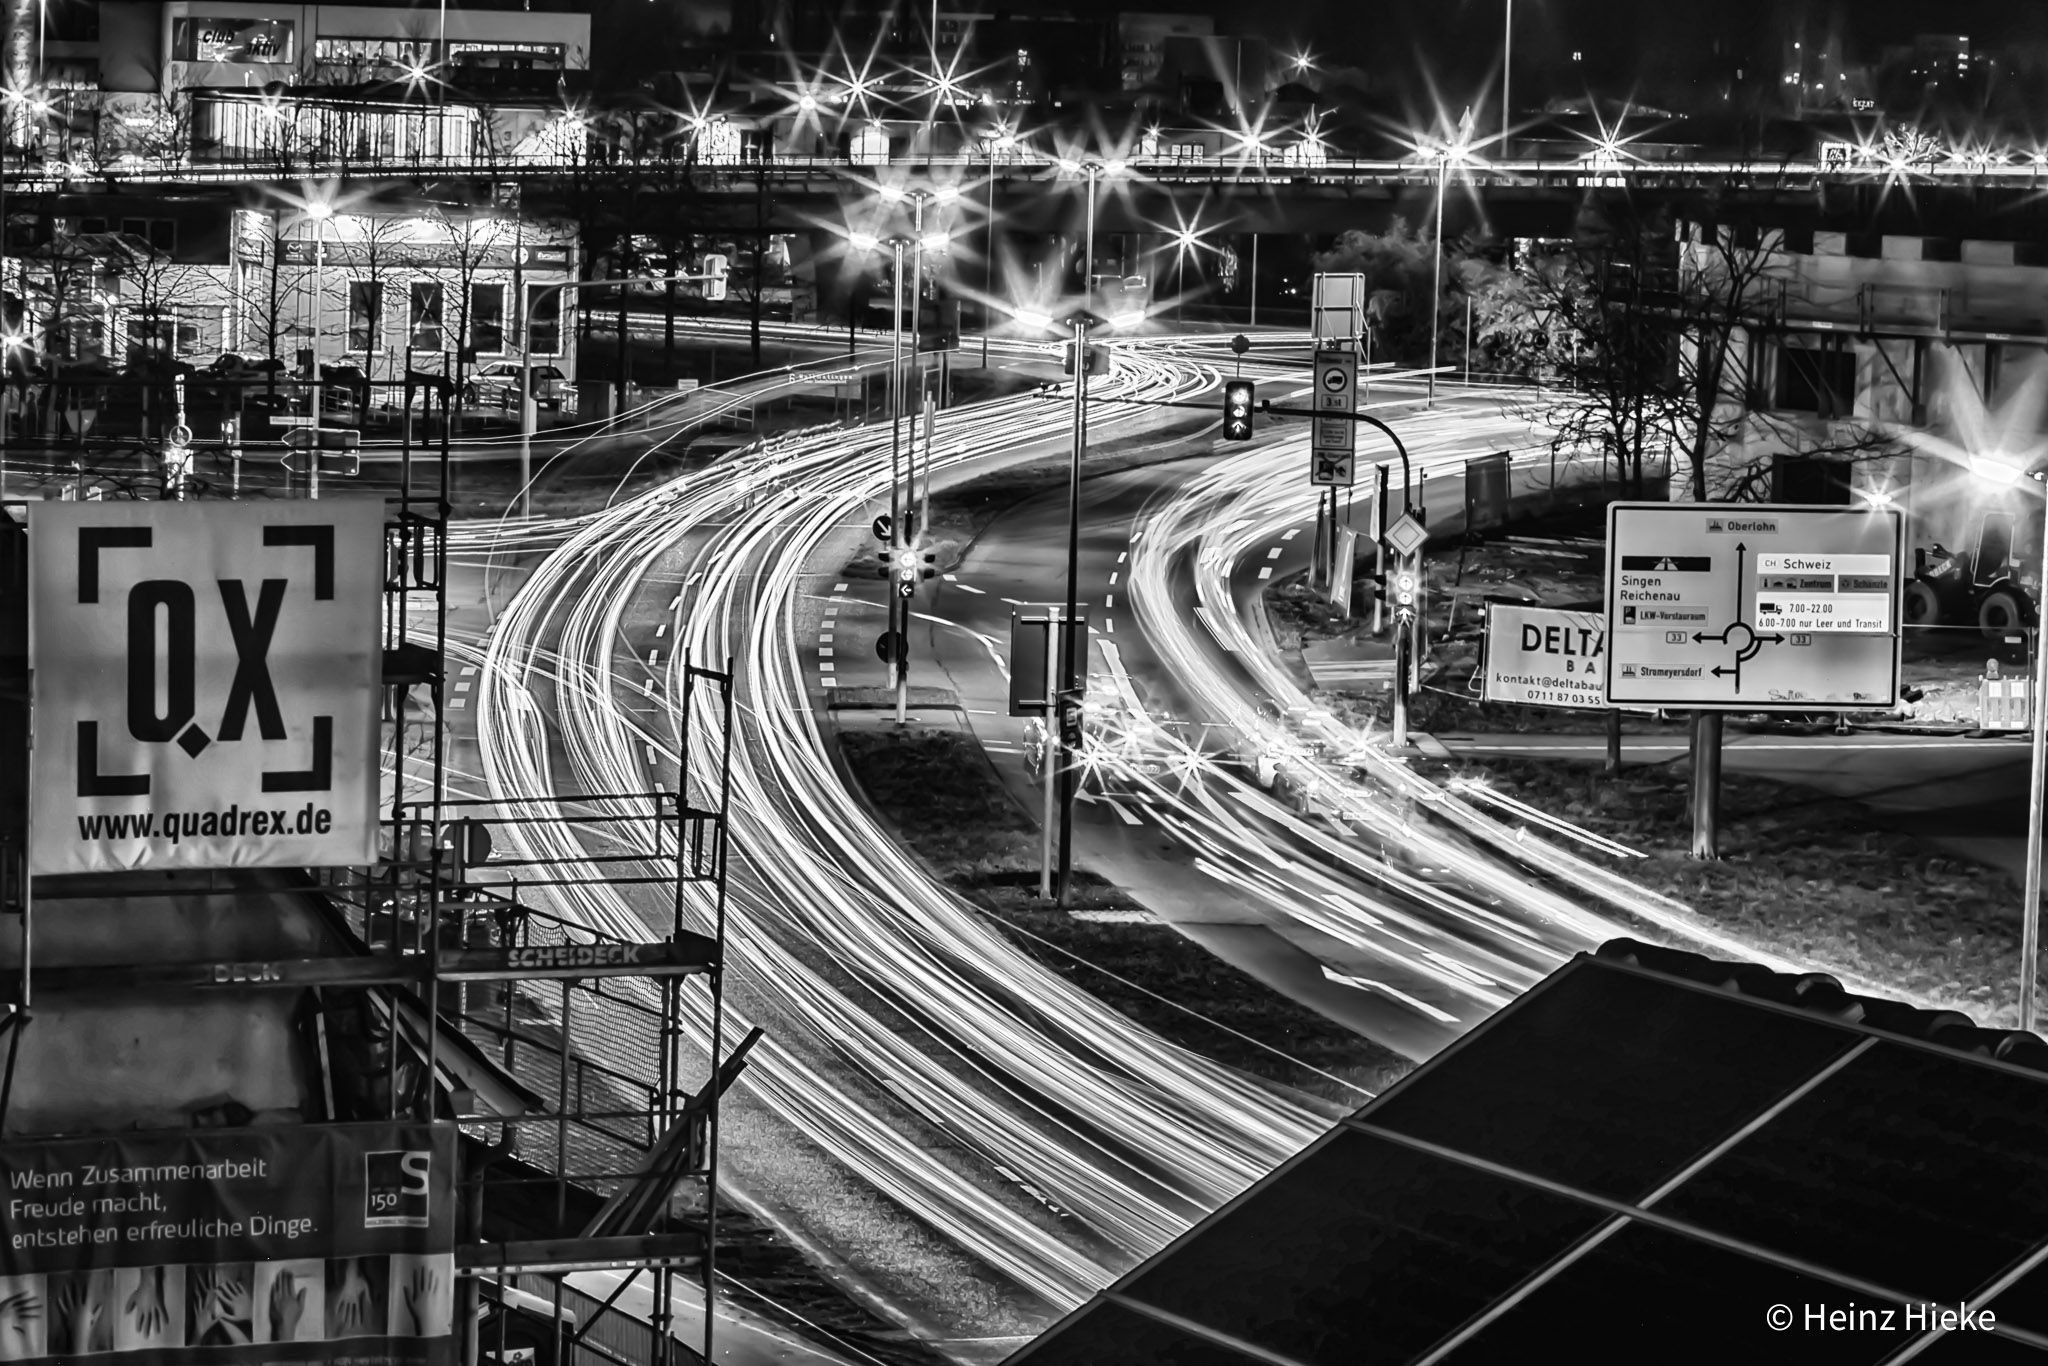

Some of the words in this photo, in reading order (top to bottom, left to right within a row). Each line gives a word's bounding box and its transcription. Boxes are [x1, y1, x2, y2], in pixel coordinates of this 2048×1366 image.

[202, 28, 235, 44] club
[1727, 521, 1776, 532] Oberlohn
[1764, 559, 1777, 568] CH
[1783, 558, 1832, 570] Schweiz
[1621, 575, 1662, 588] Singen
[1799, 579, 1833, 589] Zentrum
[1620, 590, 1681, 601] Reichenau
[1799, 620, 1813, 628] nur
[1816, 619, 1834, 628] Leer
[1837, 619, 1852, 629] und
[1856, 619, 1883, 629] Transit
[1671, 633, 1682, 642] 33
[1795, 635, 1806, 644] 33
[1527, 690, 1553, 699] 0711
[1557, 693, 1569, 703] 87
[1572, 694, 1585, 703] 03
[1588, 695, 1601, 705] 55
[77, 803, 332, 844] www.quadrex.de
[508, 945, 641, 968] SCHEIDECK
[11, 1168, 73, 1190] Wenn
[81, 1158, 267, 1186] Zusammenarbeit
[10, 1199, 85, 1220] Freude
[92, 1193, 167, 1214] macht,
[371, 1193, 397, 1212] 150
[12, 1225, 118, 1250] entstehen
[127, 1218, 243, 1242] erfreuliche
[250, 1215, 319, 1240] Dinge.
